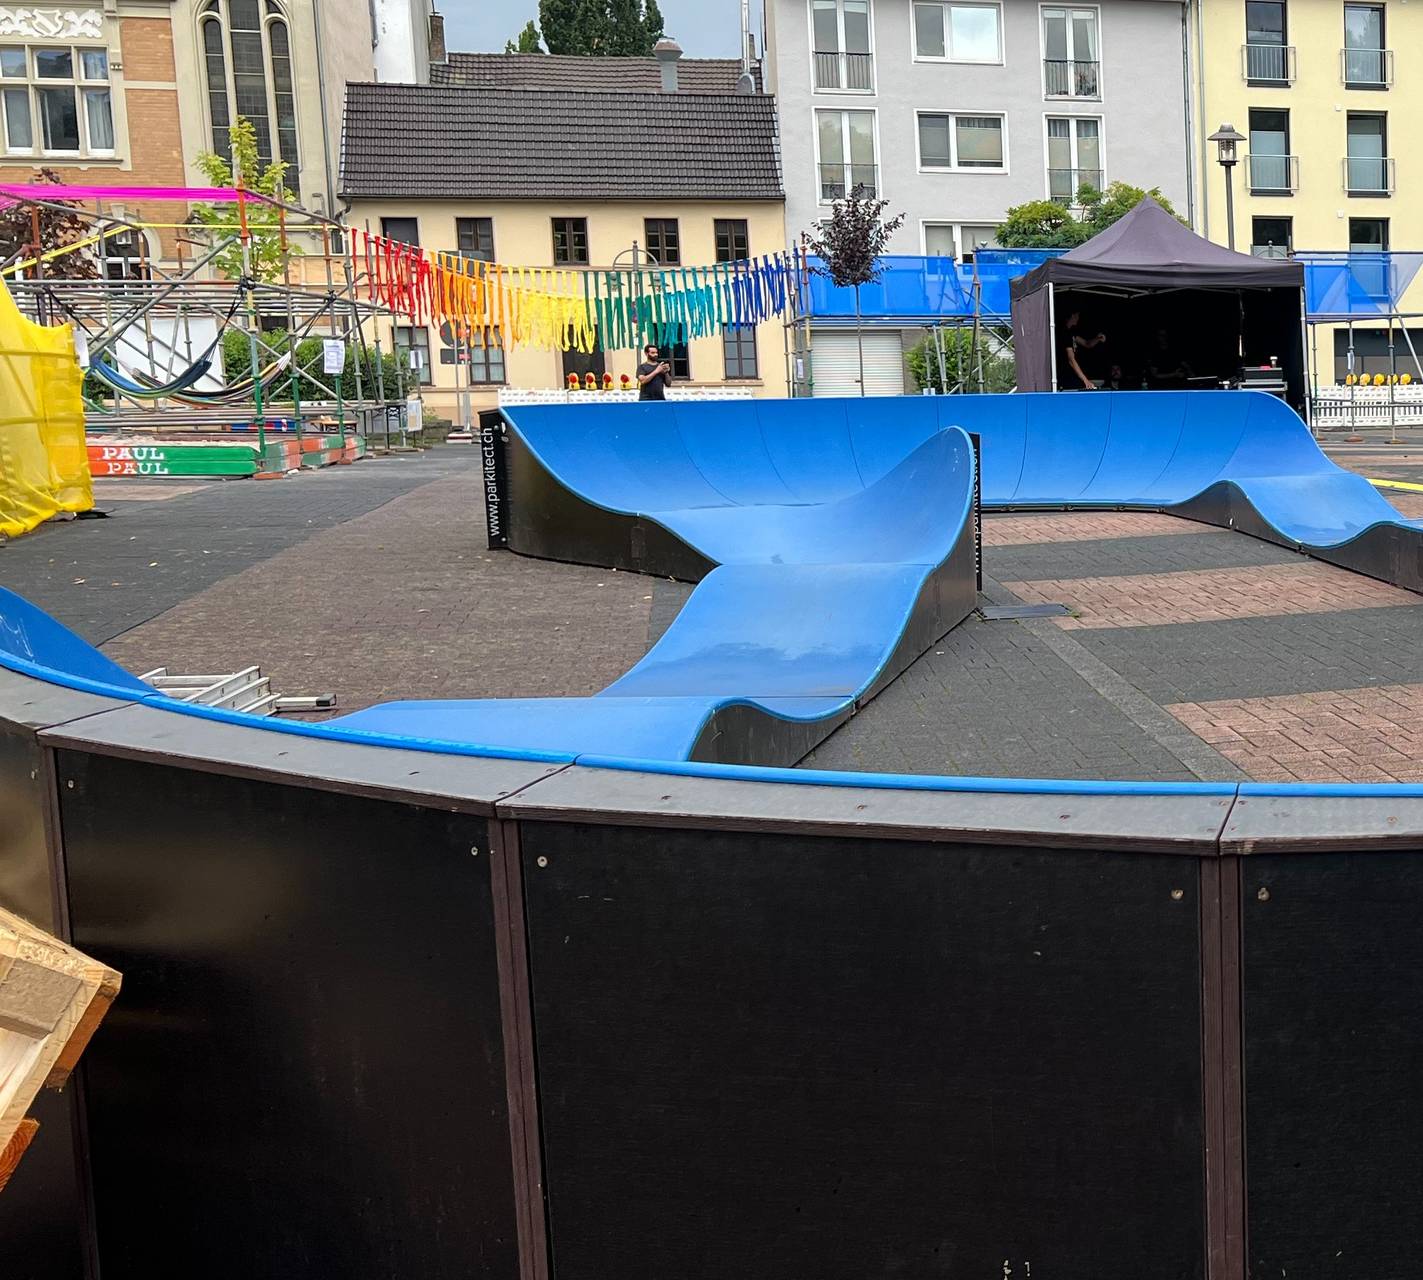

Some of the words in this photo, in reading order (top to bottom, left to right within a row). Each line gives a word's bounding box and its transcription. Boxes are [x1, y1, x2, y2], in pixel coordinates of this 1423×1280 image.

[102, 447, 164, 460] PAUL
[107, 462, 169, 474] PAUL
[481, 427, 500, 536] www.parkitect.ch
